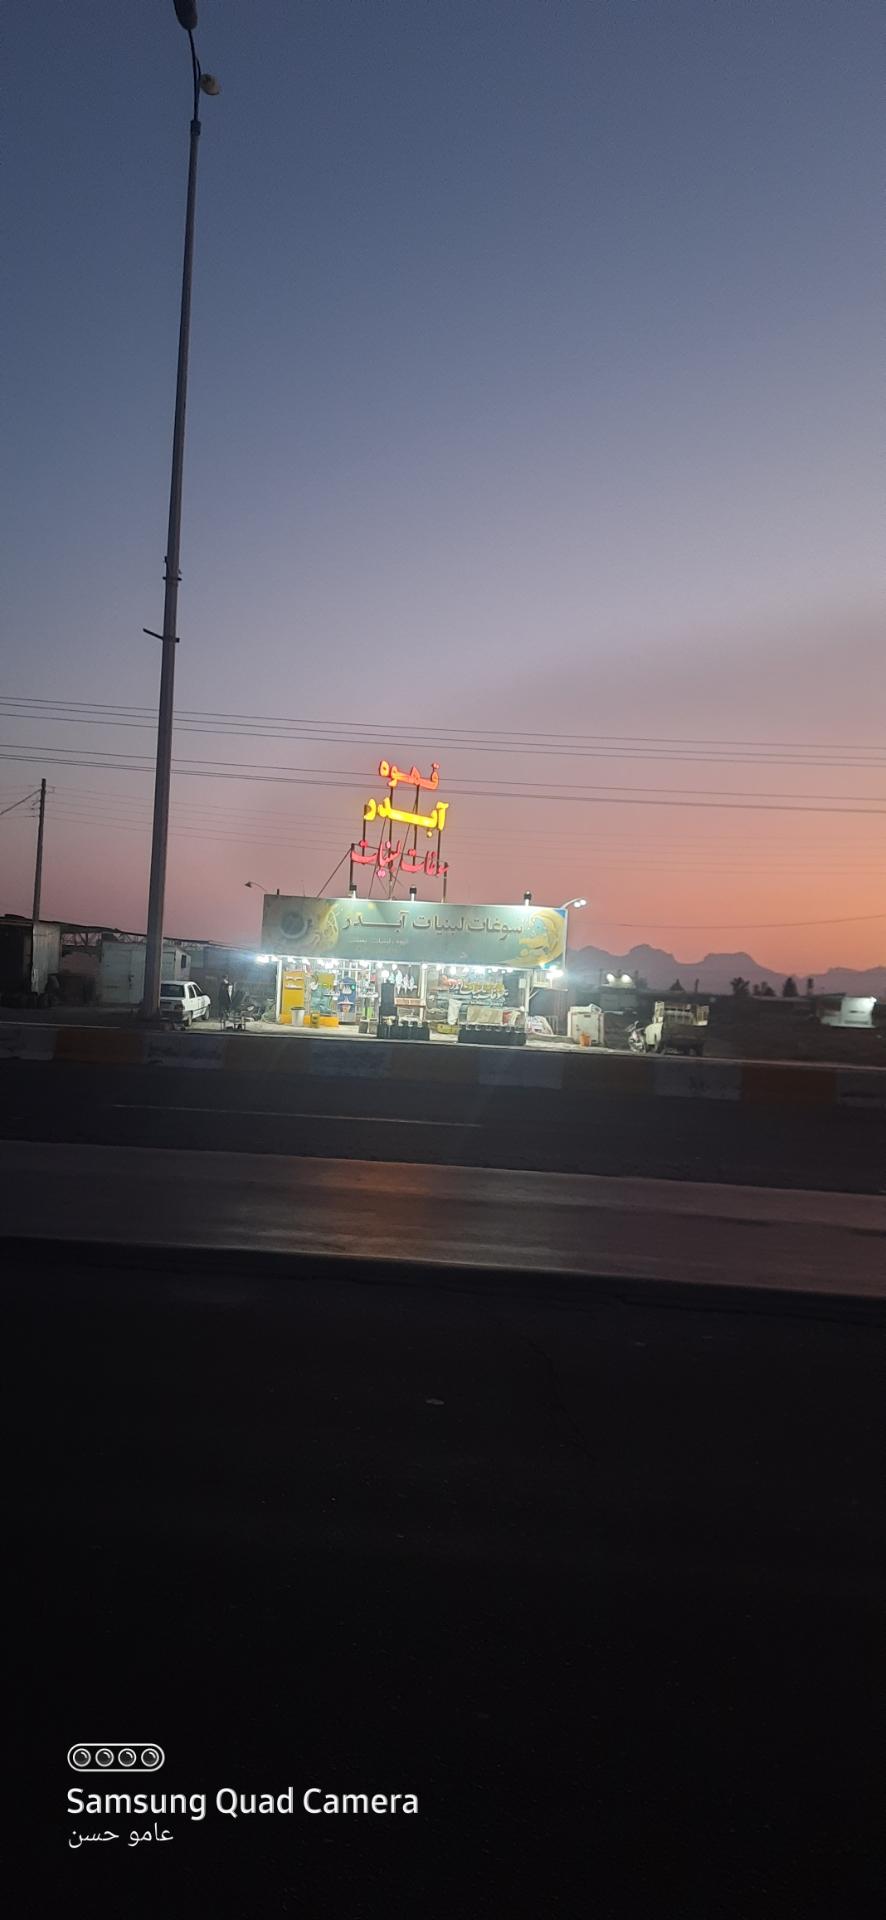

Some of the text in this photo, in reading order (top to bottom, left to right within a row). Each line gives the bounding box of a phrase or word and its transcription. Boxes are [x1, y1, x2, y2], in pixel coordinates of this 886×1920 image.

[379, 760, 439, 789] قهوه
[363, 797, 449, 837] آبدر
[342, 910, 524, 941] سوغات لبنیات آبدر
